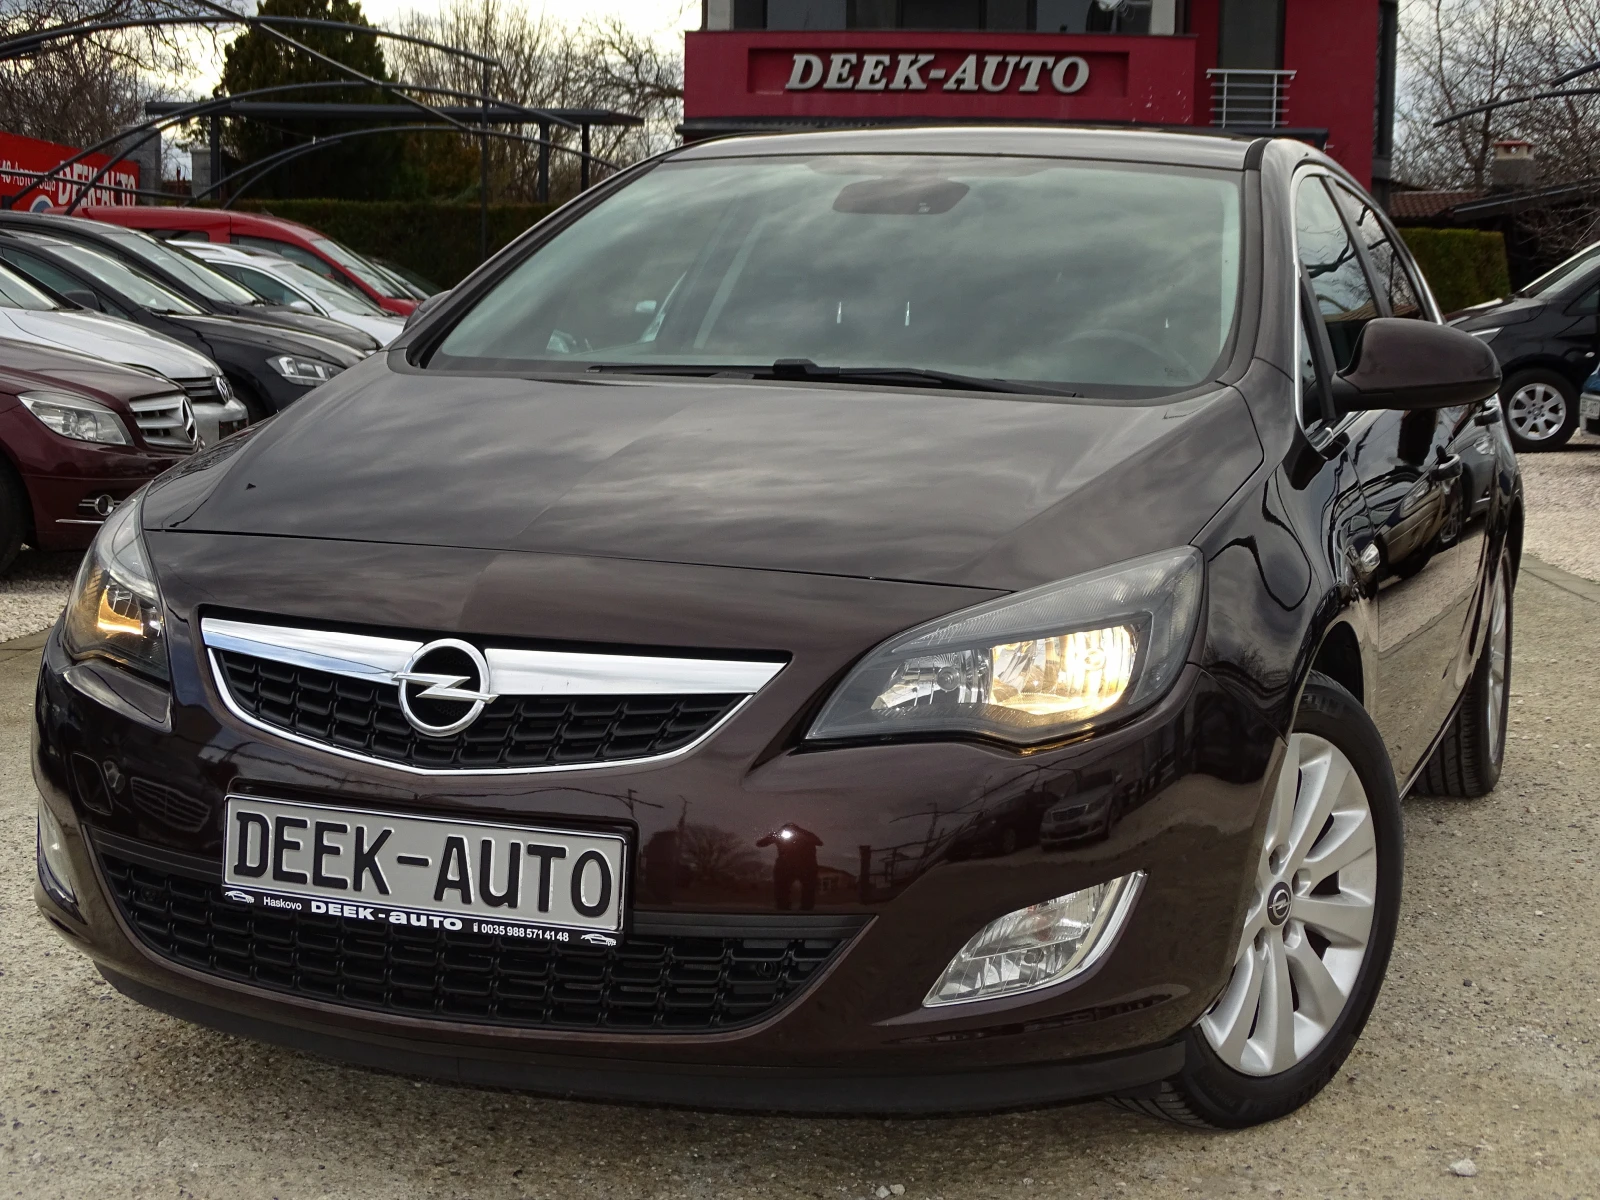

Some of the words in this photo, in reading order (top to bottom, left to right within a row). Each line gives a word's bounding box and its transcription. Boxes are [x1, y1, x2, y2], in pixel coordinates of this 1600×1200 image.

[785, 53, 1090, 94] DEEK-AUTO
[233, 811, 613, 917] DEEK-AUTO
[263, 896, 302, 911] Haskovo
[481, 923, 506, 936] 0035
[507, 926, 525, 938] 988
